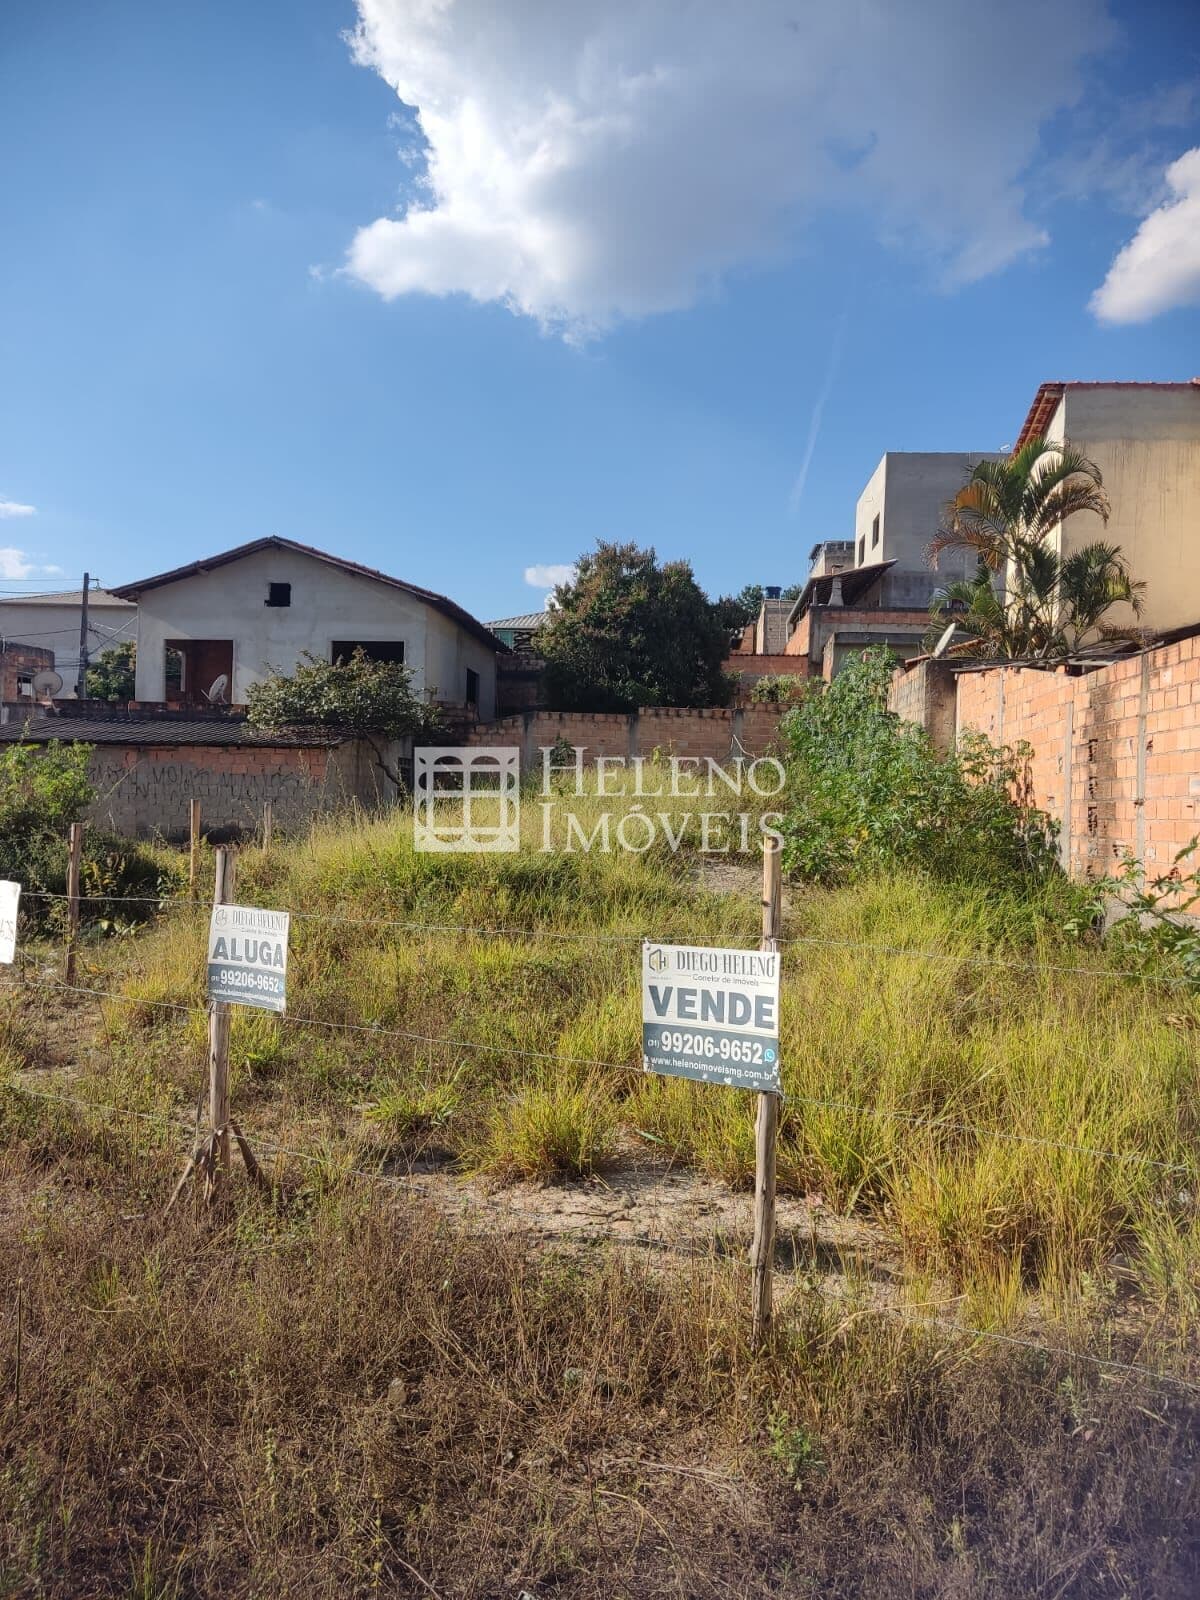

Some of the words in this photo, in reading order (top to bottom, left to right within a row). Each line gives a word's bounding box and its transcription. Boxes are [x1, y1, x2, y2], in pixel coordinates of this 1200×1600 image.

[212, 936, 284, 969] ALUGA
[676, 950, 718, 973] DIEGO
[723, 954, 775, 978] HELENO
[220, 969, 279, 993] 99206-9652
[648, 985, 775, 1030] VENDE
[661, 1031, 763, 1064] 99206-9652
